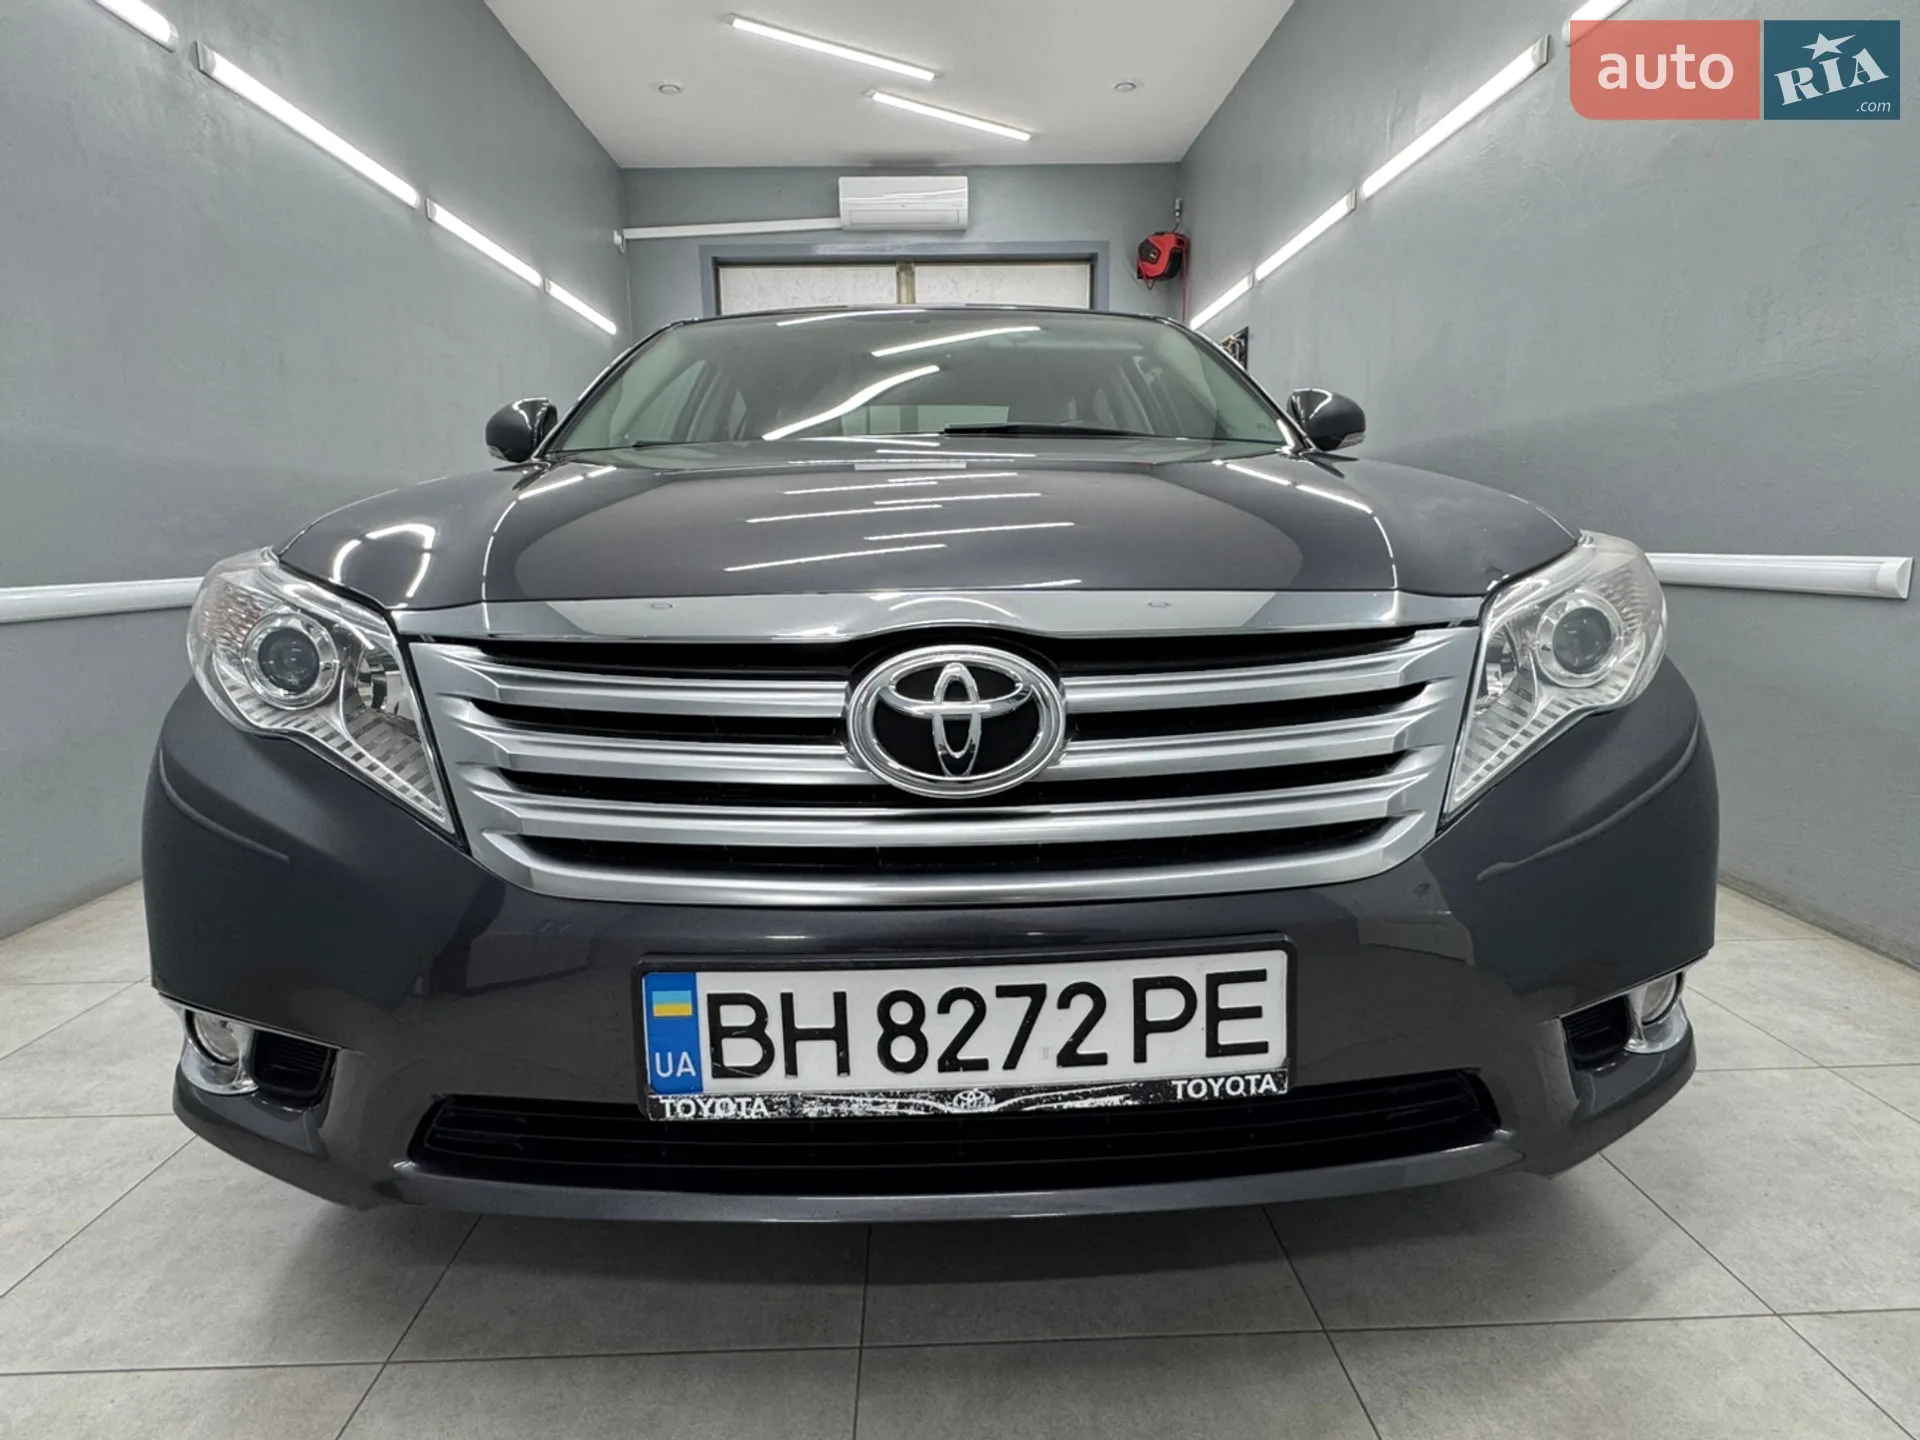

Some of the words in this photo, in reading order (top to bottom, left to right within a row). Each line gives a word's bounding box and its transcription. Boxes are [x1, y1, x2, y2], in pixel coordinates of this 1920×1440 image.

[707, 991, 850, 1079] BH
[877, 981, 1108, 1074] 8272
[1133, 969, 1269, 1063] PE
[655, 1051, 697, 1078] UA
[1171, 1073, 1278, 1100] TOYOTA
[659, 1097, 771, 1120] TOYOTA
